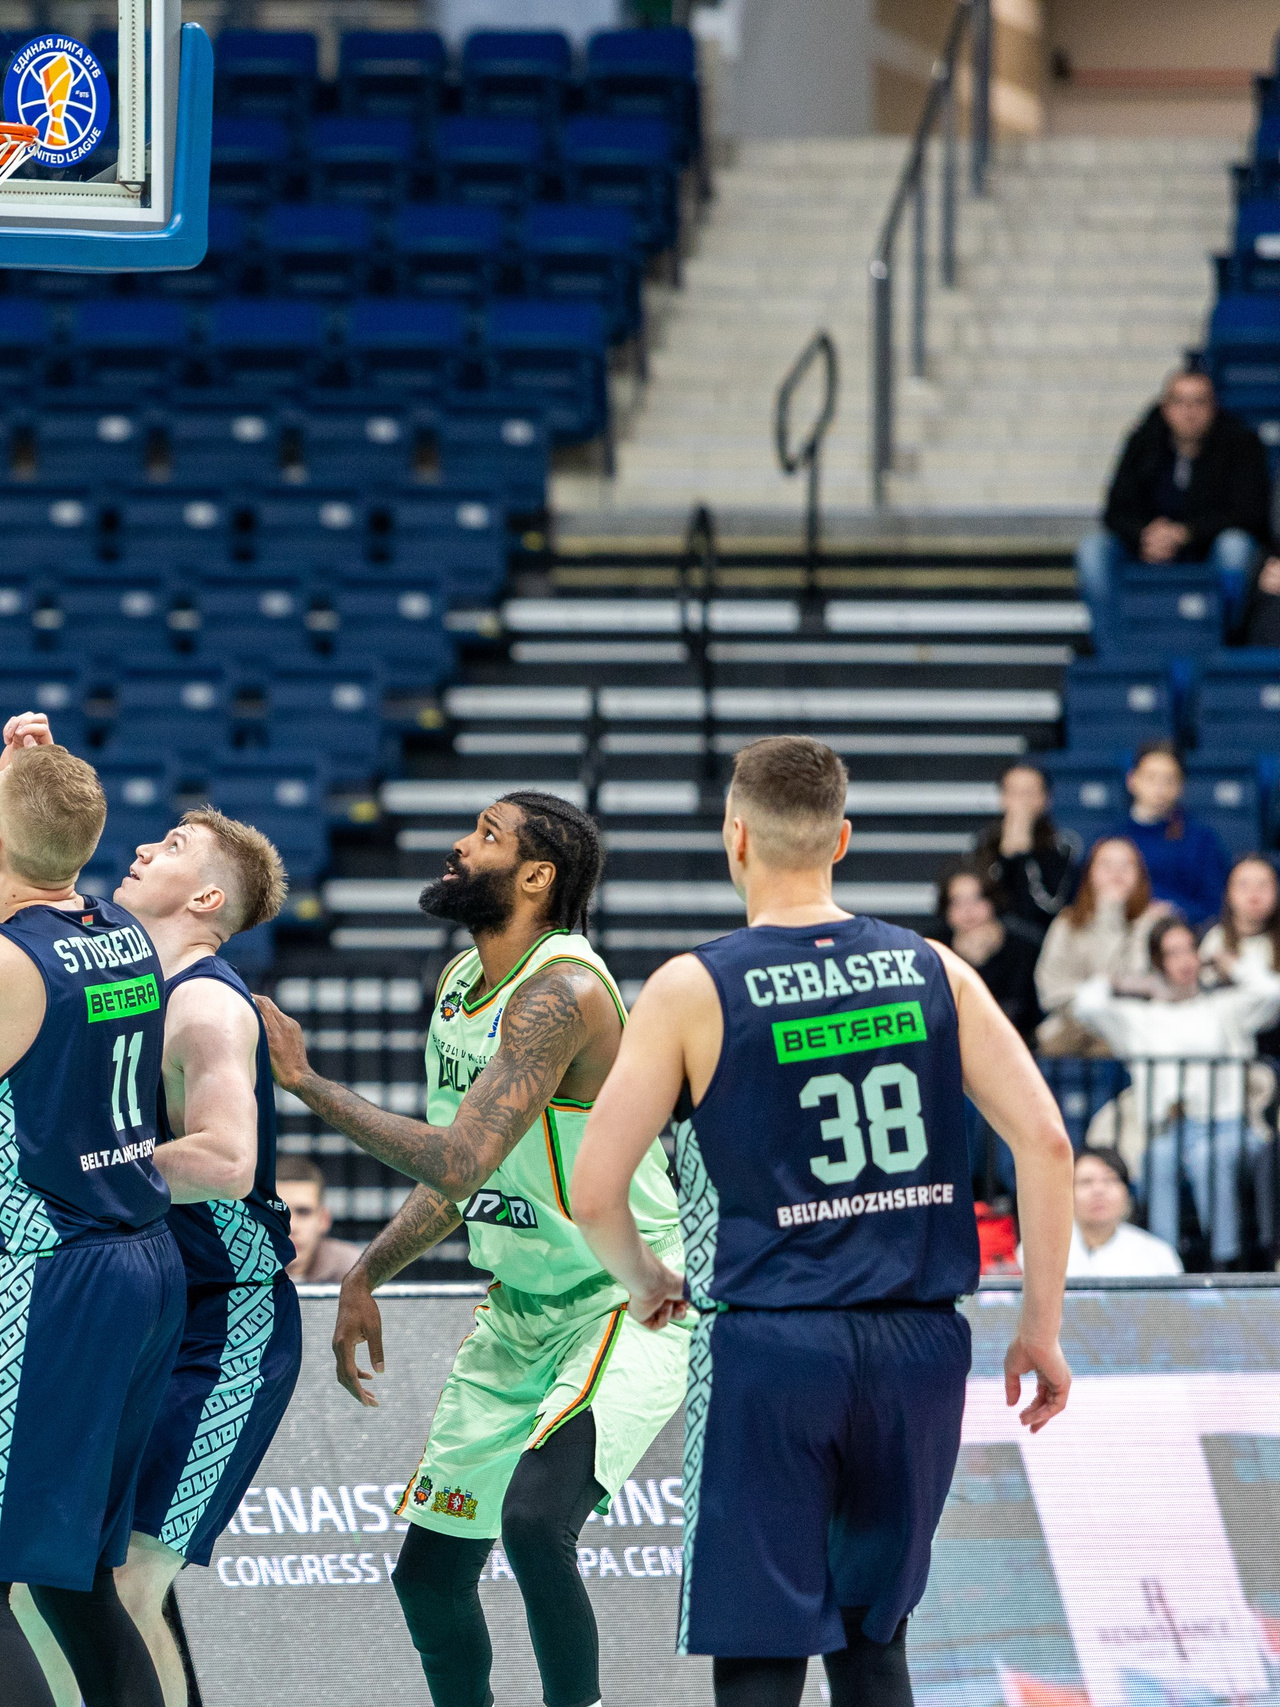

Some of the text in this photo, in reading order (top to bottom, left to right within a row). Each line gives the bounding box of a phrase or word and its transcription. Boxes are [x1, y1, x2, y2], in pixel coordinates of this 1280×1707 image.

[12, 38, 102, 79] ЕДИНАЯ ЛИГА ВТБ
[66, 127, 102, 163] LEAGUE
[53, 924, 153, 974] STUBEDA
[91, 982, 157, 1015] BETERA
[744, 949, 926, 1008] CEBASEK
[782, 1010, 917, 1053] BETERA
[111, 1031, 144, 1132] 11
[798, 1062, 929, 1186] 38
[228, 1482, 412, 1534] ENAISS
[217, 1553, 381, 1586] CONGRESS
